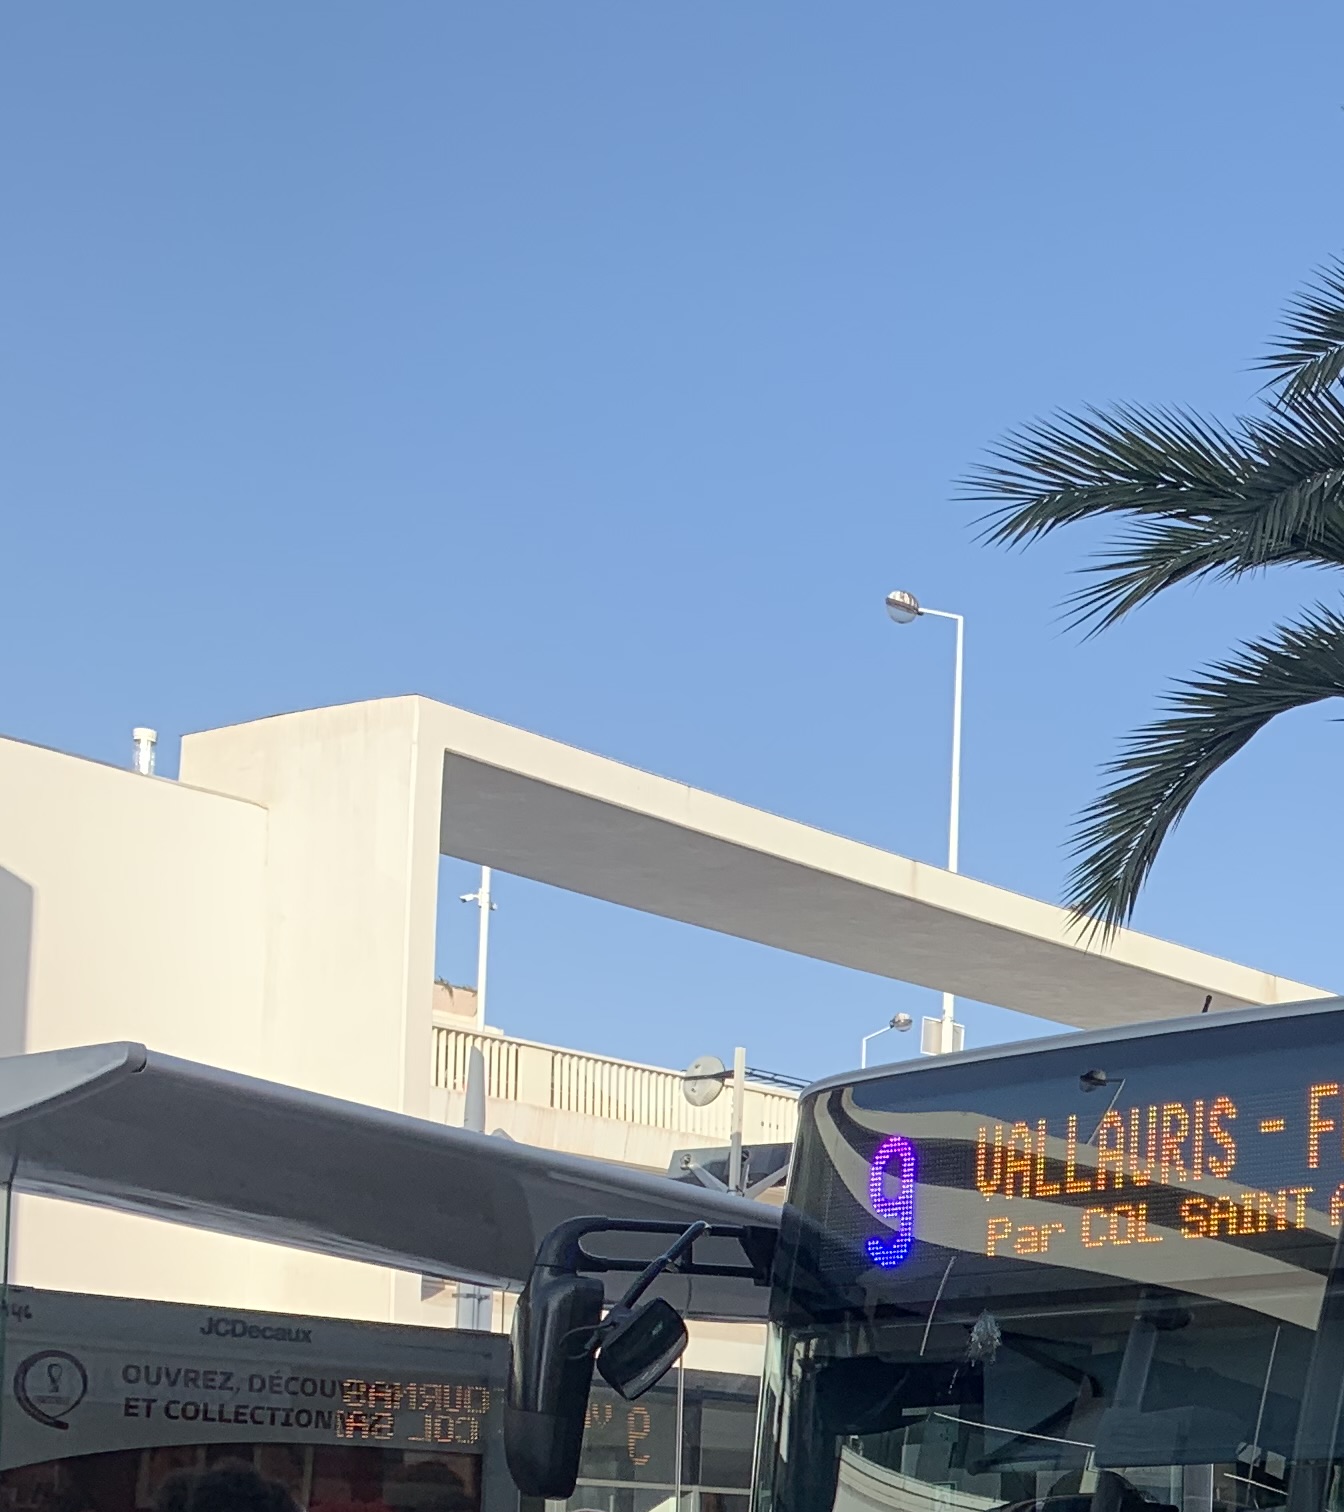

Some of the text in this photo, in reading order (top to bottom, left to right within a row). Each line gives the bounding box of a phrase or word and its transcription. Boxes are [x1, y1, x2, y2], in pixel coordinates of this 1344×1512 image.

[976, 1096, 1238, 1202] VALLAURIS
[867, 1136, 916, 1266] 9
[985, 1216, 1066, 1257] Par
[1179, 1186, 1315, 1239] SAINT
[200, 1316, 313, 1344] JCDecaux
[122, 1363, 240, 1394] OUVREZ,
[123, 1398, 156, 1418] ET
